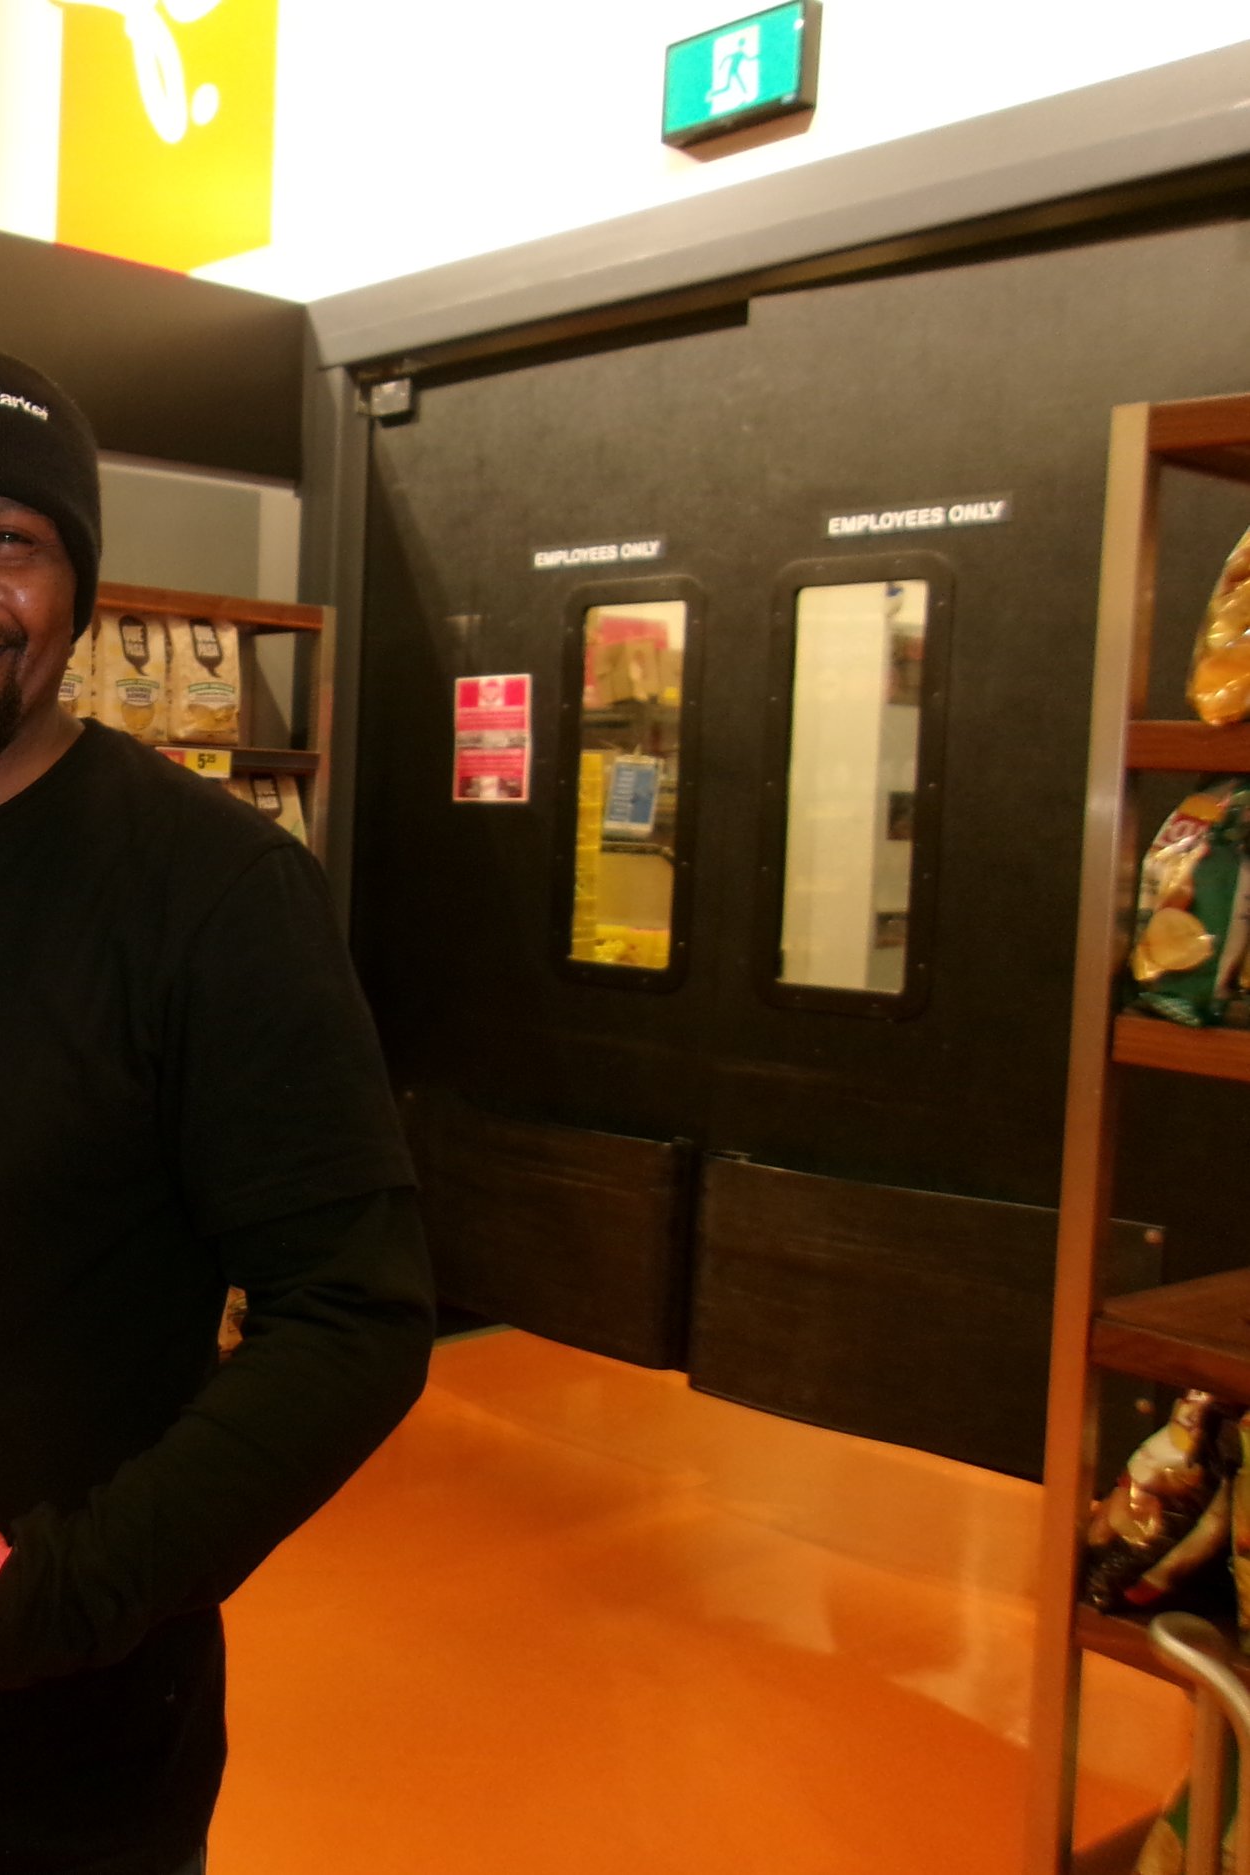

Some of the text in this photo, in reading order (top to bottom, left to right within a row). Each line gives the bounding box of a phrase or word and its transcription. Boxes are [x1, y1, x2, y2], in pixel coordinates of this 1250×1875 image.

[828, 500, 1005, 536] EMPLOYEES ONLY
[534, 540, 661, 569] EMPLOYEES ONLY
